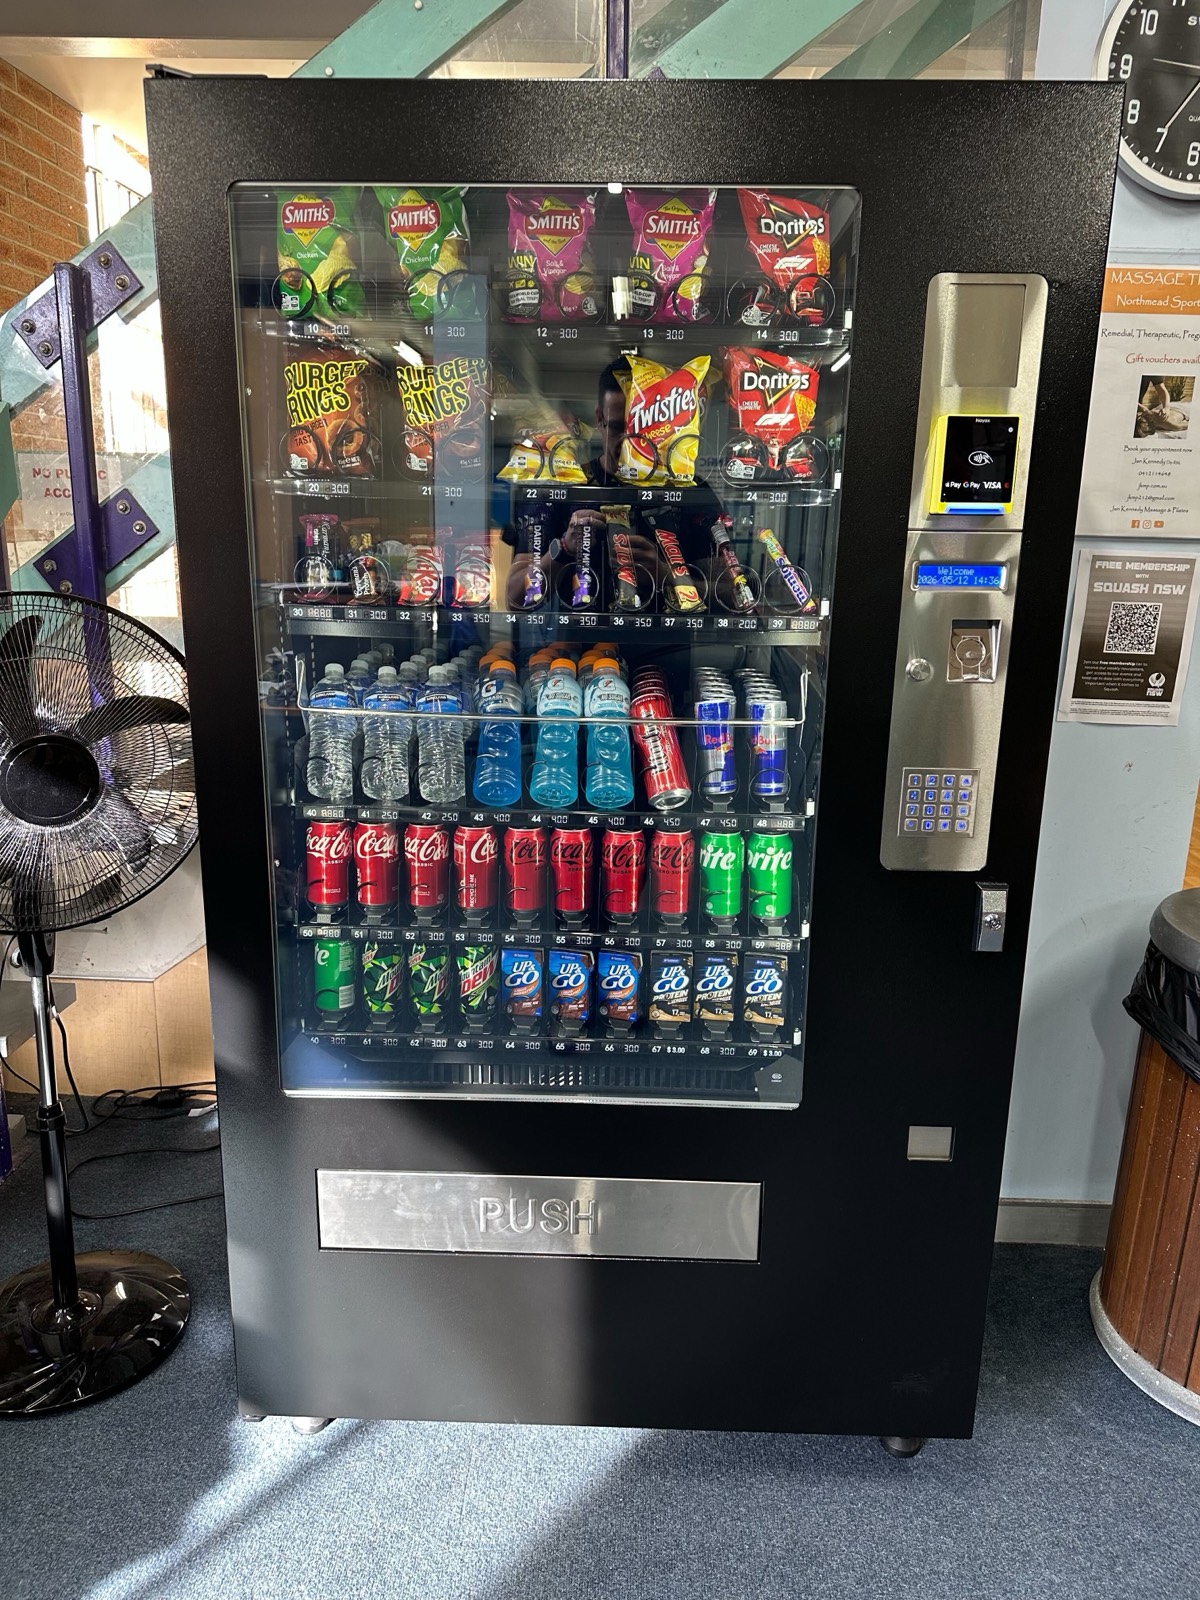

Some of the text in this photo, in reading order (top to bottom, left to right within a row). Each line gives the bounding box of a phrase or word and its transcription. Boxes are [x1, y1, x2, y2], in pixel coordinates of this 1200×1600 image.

[1140, 9, 1159, 35] 10
[1119, 54, 1133, 79] 9
[1127, 99, 1141, 124] 8
[1155, 127, 1169, 153] 7
[1187, 142, 1200, 166] 6
[284, 204, 330, 224] SMITH'S
[390, 206, 436, 228] SMITH'S
[527, 212, 580, 230] SMITH'S
[646, 215, 701, 236] SMITH'S
[760, 217, 825, 236] Doritos
[405, 256, 430, 264] Chicken
[1110, 271, 1186, 286] MASSAGE
[1116, 294, 1169, 307] Northmead
[308, 323, 319, 334] 10
[424, 325, 434, 335] 11
[536, 328, 548, 337] 12
[642, 329, 654, 338] 13
[756, 330, 768, 340] 14
[1126, 352, 1180, 364] Gift vouchers
[743, 372, 810, 390] Doritos
[286, 381, 351, 428] RINGS
[402, 381, 471, 426] RINGS
[629, 386, 697, 434] Twisties
[32, 468, 51, 478] NO
[308, 483, 320, 492] 20
[970, 482, 980, 490] Pay
[422, 486, 432, 496] 21
[526, 489, 537, 498] 22
[642, 491, 653, 501] 23
[746, 492, 758, 501] 24
[1095, 560, 1190, 572] FREE MEMBERSHIP
[938, 566, 975, 576] Welcome
[918, 576, 1000, 585] 2026/05/12 14:36
[1094, 582, 1149, 594] SQUASH
[292, 608, 304, 616] 30
[348, 610, 358, 618] 31
[400, 611, 410, 620] 32
[452, 612, 462, 621] 33
[506, 614, 516, 623] 34
[558, 616, 569, 625] 35
[613, 616, 624, 626] 36
[664, 618, 675, 626] 37
[718, 618, 728, 627] 38
[772, 619, 783, 628] 39
[306, 808, 317, 818] 40
[361, 810, 370, 818] 41
[421, 812, 432, 820] 42
[474, 812, 484, 821] 43
[531, 814, 542, 823] 44
[588, 816, 599, 824] 45
[644, 817, 654, 826] 46
[700, 818, 711, 827] 47
[756, 819, 768, 828] 48
[302, 929, 313, 937] 50
[354, 930, 364, 939] 51
[405, 931, 416, 940] 52
[455, 932, 465, 941] 53
[504, 934, 515, 942] 54
[555, 936, 566, 944] 55
[604, 937, 615, 945] 56
[656, 938, 666, 946] 57
[705, 940, 716, 948] 58
[755, 940, 765, 949] 59
[505, 970, 540, 986] GO
[552, 973, 586, 988] GO
[602, 975, 636, 990] GO
[652, 976, 690, 992] GO
[696, 975, 734, 992] GO
[746, 979, 783, 994] GO
[652, 990, 688, 1002] PROTEIN
[696, 988, 733, 1001] PROTEIN
[746, 992, 783, 1004] PROTEIN
[362, 1038, 372, 1046] 61
[409, 1038, 420, 1047] 62
[457, 1040, 467, 1048] 63
[505, 1040, 515, 1049] 64
[555, 1042, 566, 1051] 65
[605, 1044, 615, 1052] 66
[652, 1045, 662, 1053] 67
[700, 1047, 710, 1055] 68
[748, 1049, 758, 1057] 69
[479, 1196, 600, 1236] PUSH
